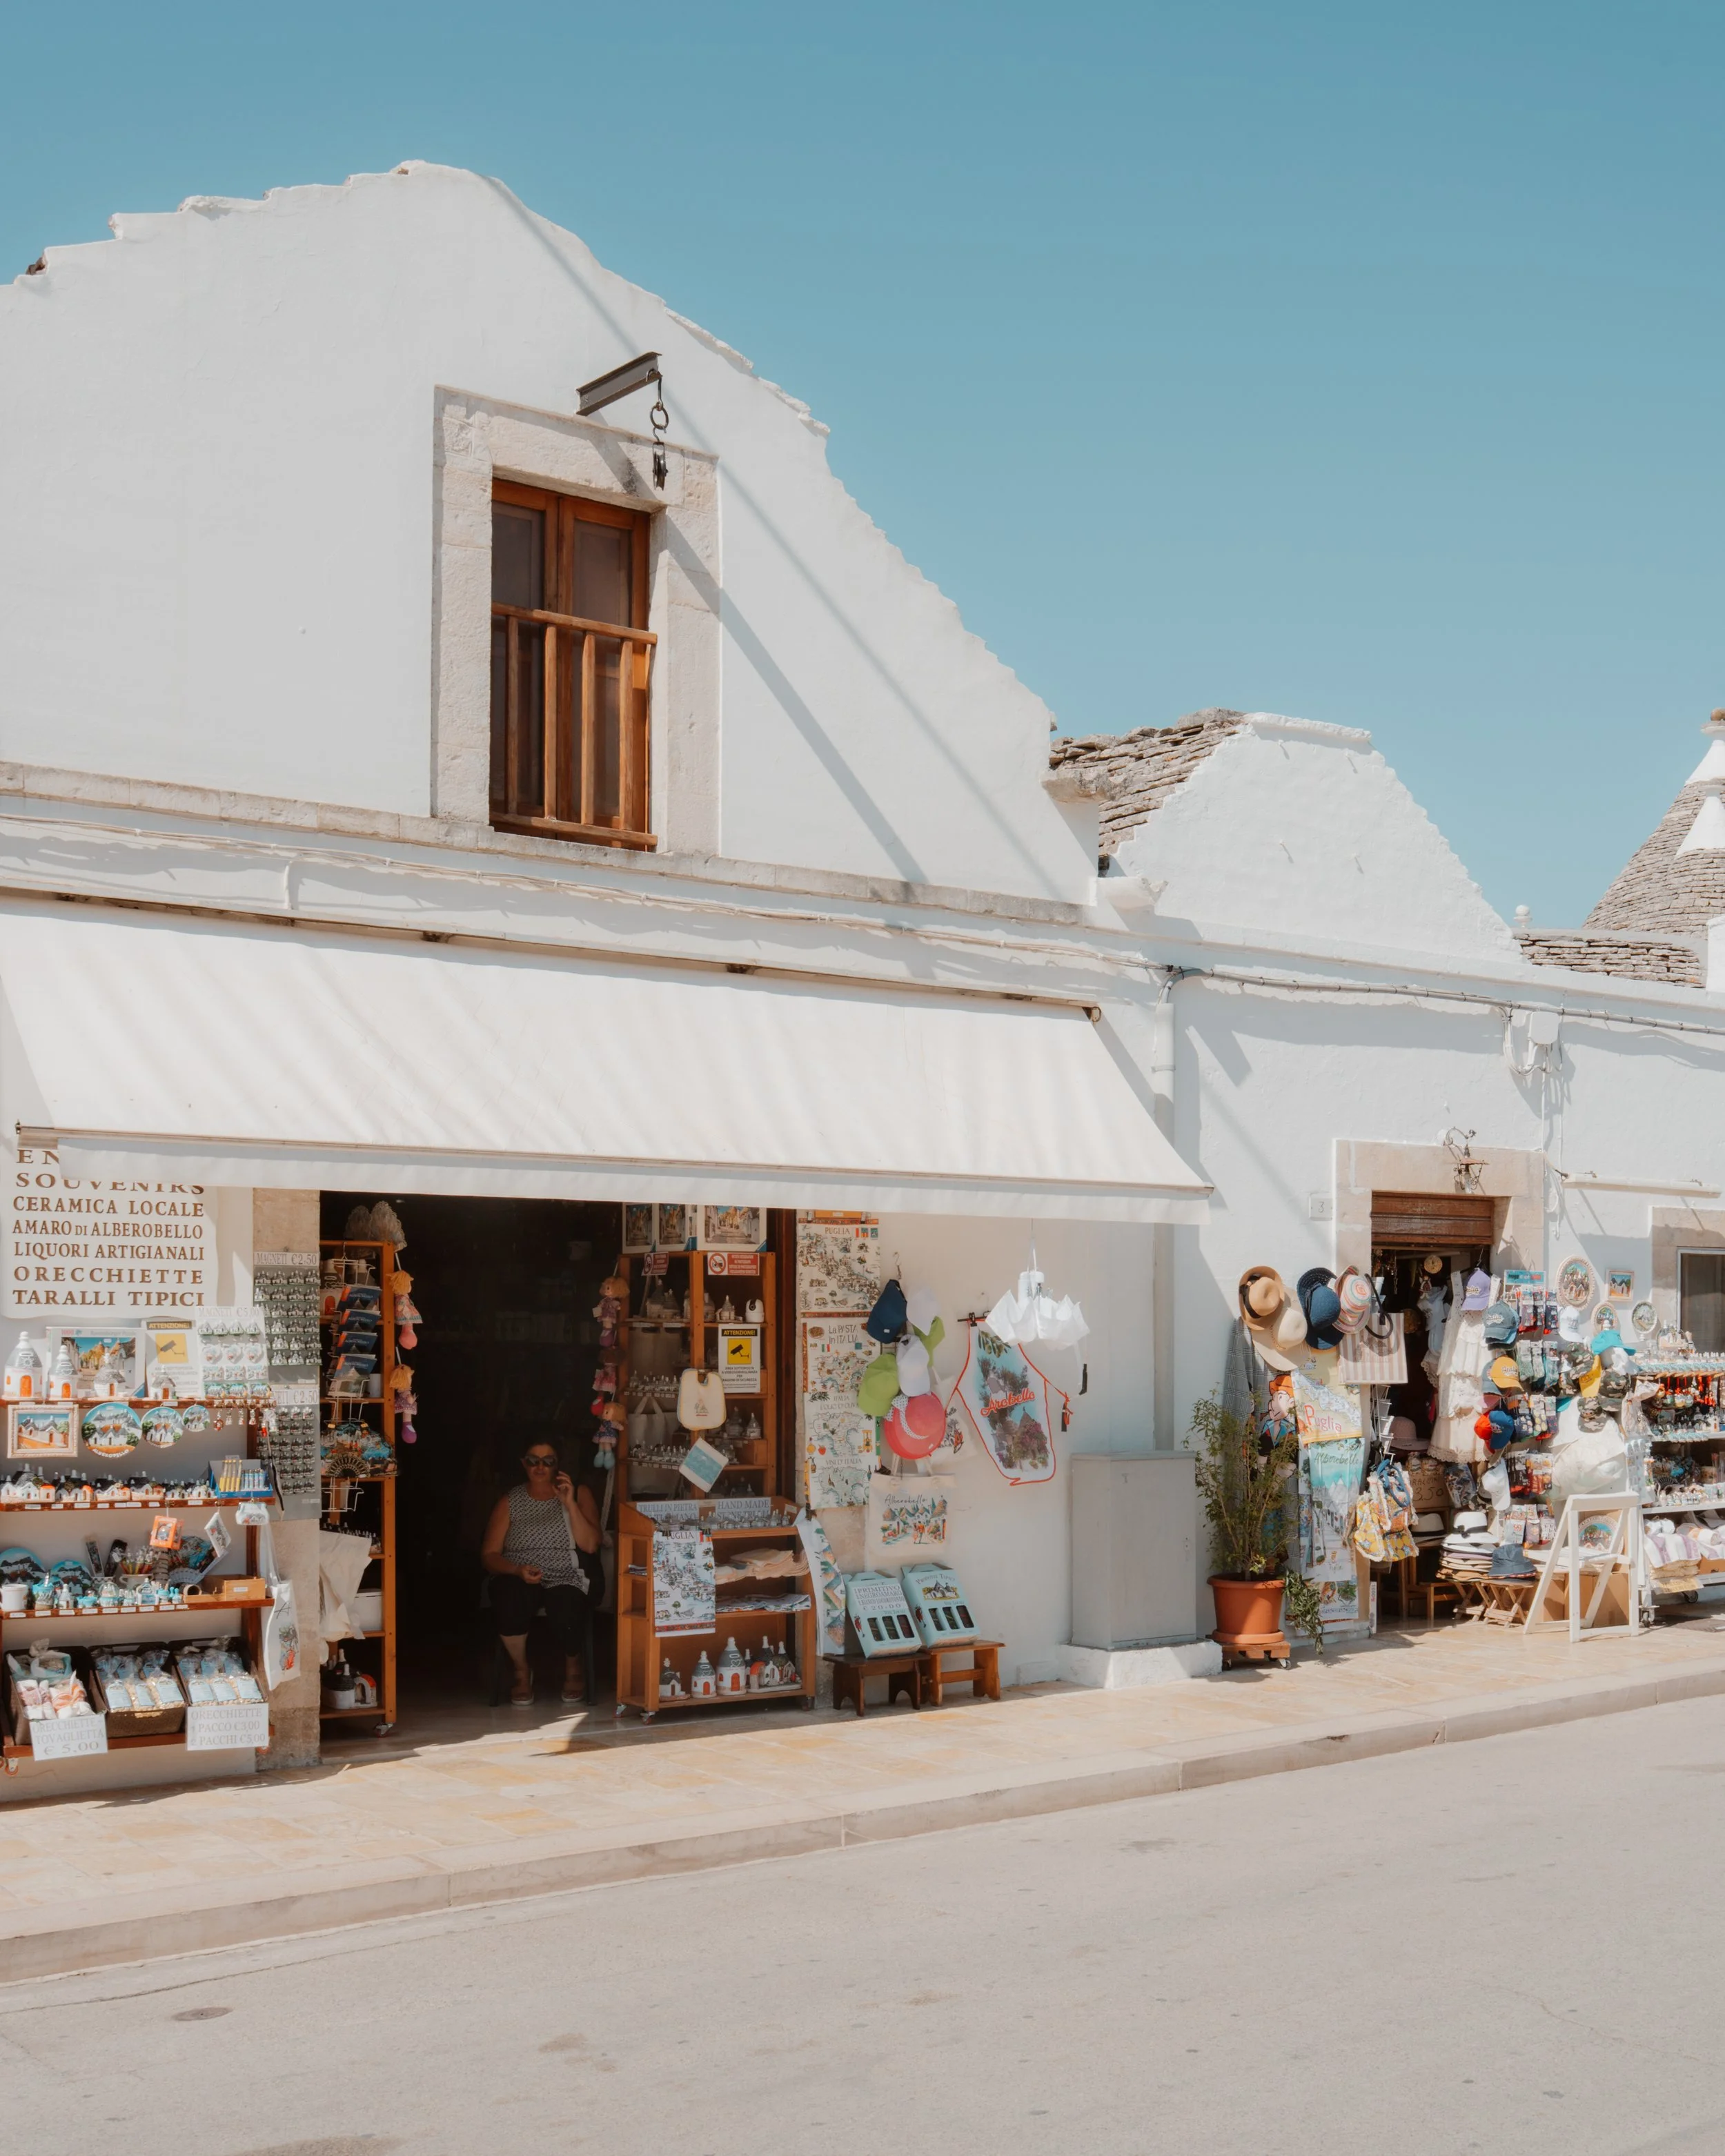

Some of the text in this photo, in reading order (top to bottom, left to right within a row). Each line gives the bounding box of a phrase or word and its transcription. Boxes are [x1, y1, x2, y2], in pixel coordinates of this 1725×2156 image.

[16, 1172, 204, 1195] SOUVENIRS
[13, 1196, 204, 1217] CERAMICA LOCALE
[12, 1219, 204, 1240] AMARO DI ALBEROBELLO
[825, 1227, 850, 1235] PUGLIA
[14, 1241, 204, 1260] LIQUORI ARTIGIANALI
[257, 1252, 288, 1265] MAGNETI
[14, 1265, 203, 1284] ORECCHIETTE
[12, 1289, 204, 1307] TARALLI TIPICI
[198, 1306, 232, 1317] MAGNETI
[829, 1325, 837, 1334] La
[1304, 1404, 1342, 1433] Puglia
[718, 1499, 769, 1510] HAND MADE
[885, 1493, 926, 1505] Alberobello
[639, 1503, 698, 1512] TRULLI IN PIETRA
[667, 1532, 694, 1540] UGLIA
[858, 1585, 900, 1594] PRIMITIVO
[860, 1590, 903, 1599] NEGROAMARO
[190, 1708, 262, 1721] ORECCHIETTE
[32, 1719, 95, 1734] ORECCHIETTE
[198, 1722, 232, 1732] PACCO
[35, 1728, 106, 1745] TOVAGLIETTA
[199, 1734, 237, 1746] PACCHI
[239, 1733, 266, 1745] €5,00
[44, 1741, 99, 1755] € 5.00
